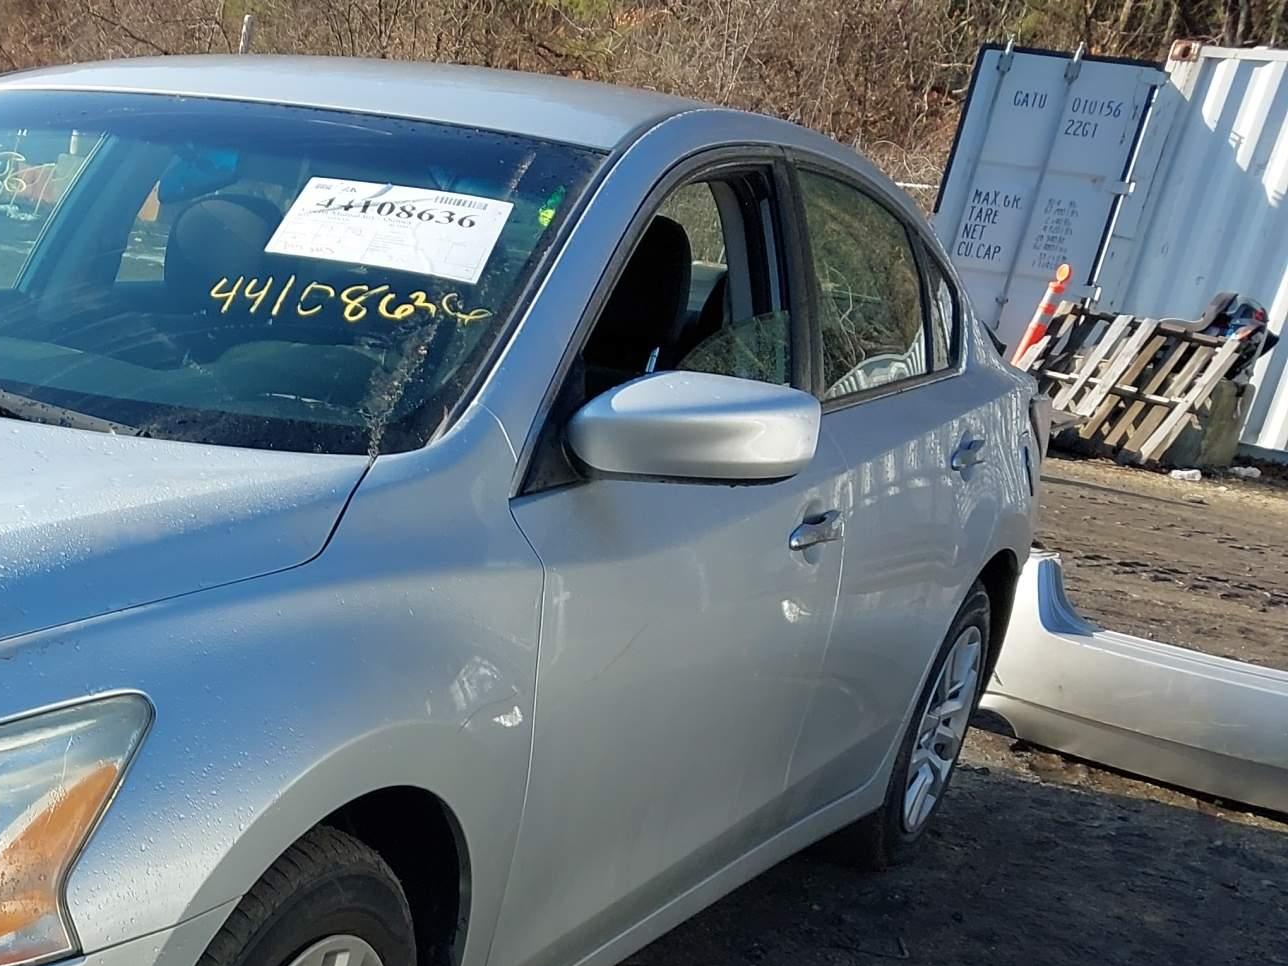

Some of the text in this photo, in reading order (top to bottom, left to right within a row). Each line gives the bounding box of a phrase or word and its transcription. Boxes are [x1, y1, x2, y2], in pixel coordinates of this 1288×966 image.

[1013, 90, 1048, 109] GATU
[1071, 97, 1124, 118] 010156
[315, 196, 480, 229] 44108636
[968, 205, 999, 225] TARE
[962, 223, 987, 241] NET
[210, 274, 494, 324] 44108636
